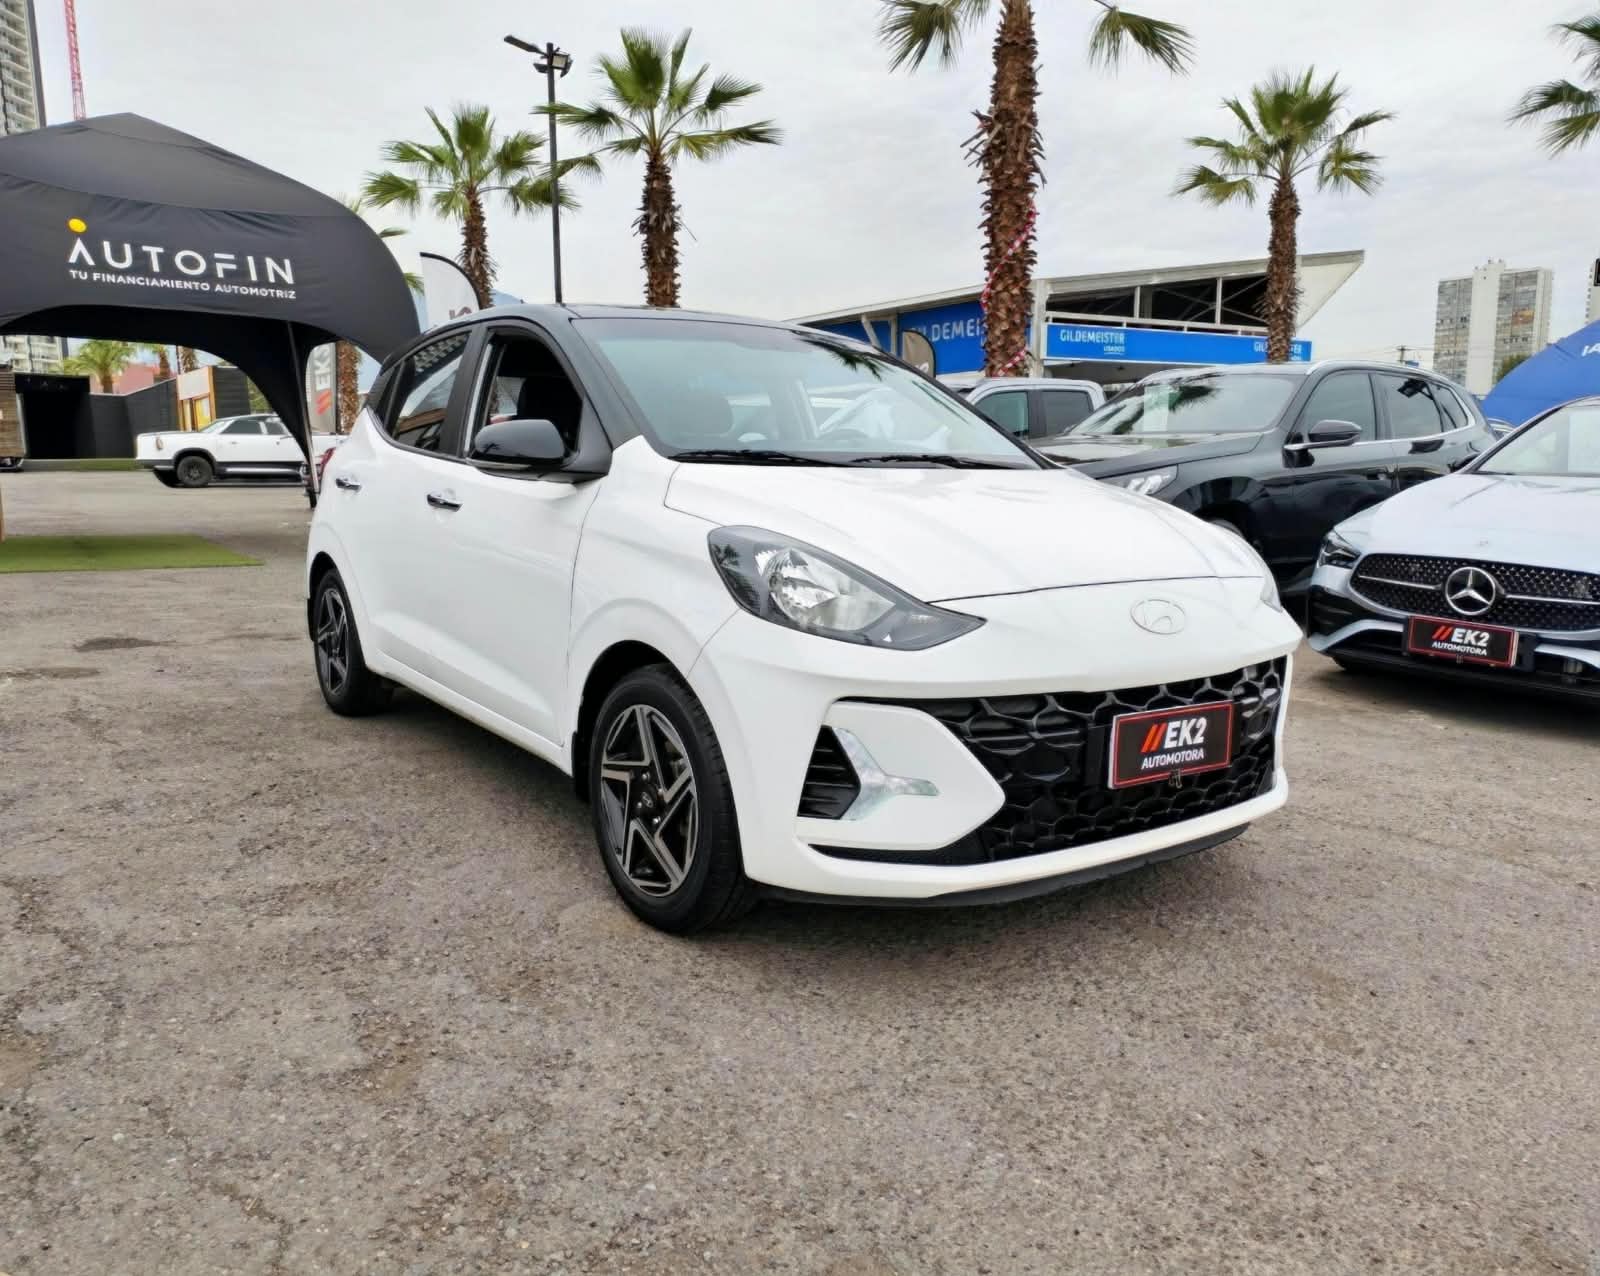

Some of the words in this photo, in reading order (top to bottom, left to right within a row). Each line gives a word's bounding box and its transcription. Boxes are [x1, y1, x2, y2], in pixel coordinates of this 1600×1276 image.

[68, 237, 294, 284] AUTOFIN
[69, 269, 88, 280] TU
[93, 272, 210, 291] FINANCIAMIENTO
[215, 283, 296, 299] AUTOMOTRIZ
[1060, 329, 1125, 344] GILDEMEISTER
[1432, 641, 1487, 656] AUTOMOTORA
[1141, 748, 1204, 769] AUTOMOTORA
